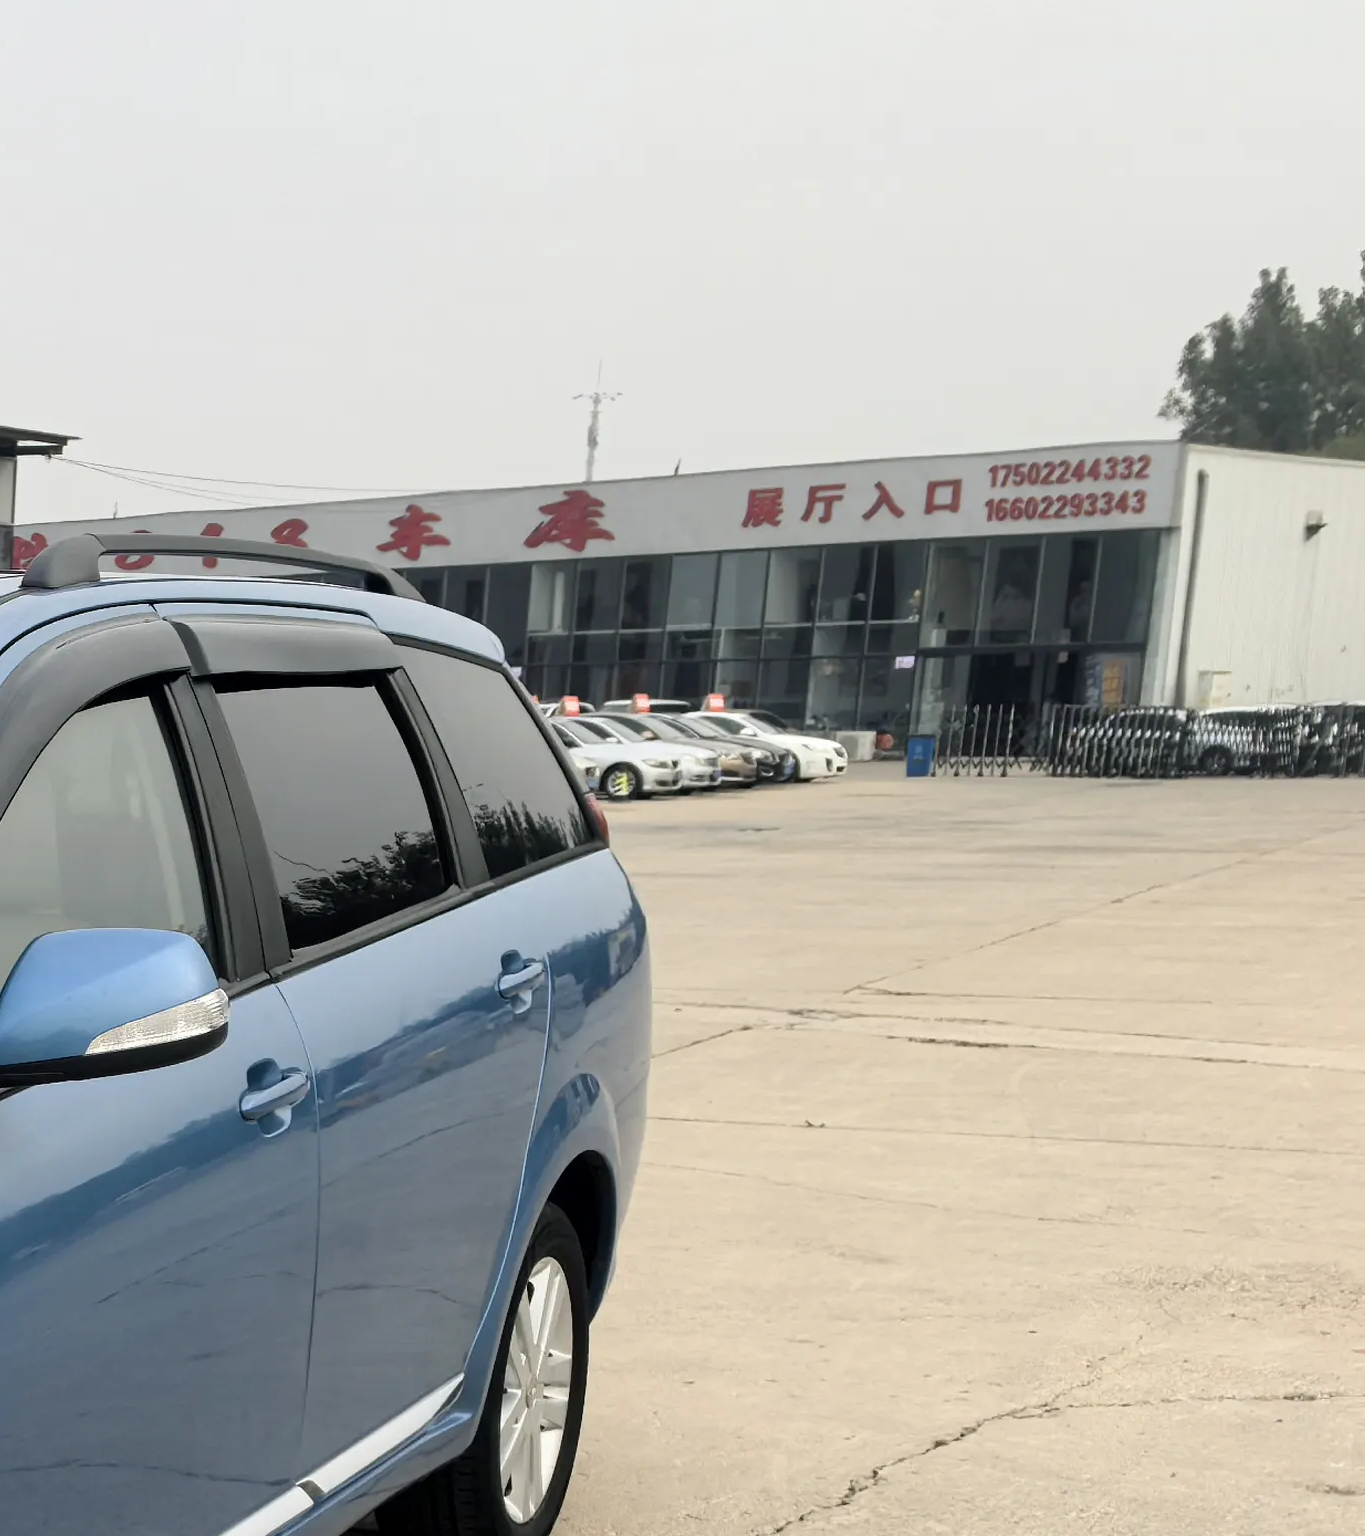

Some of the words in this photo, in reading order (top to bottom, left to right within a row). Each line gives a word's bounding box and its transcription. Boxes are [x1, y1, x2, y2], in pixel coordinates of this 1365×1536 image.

[988, 454, 1152, 488] 17502244332
[741, 478, 963, 528] 展厅入口
[985, 488, 1148, 522] 16602293343
